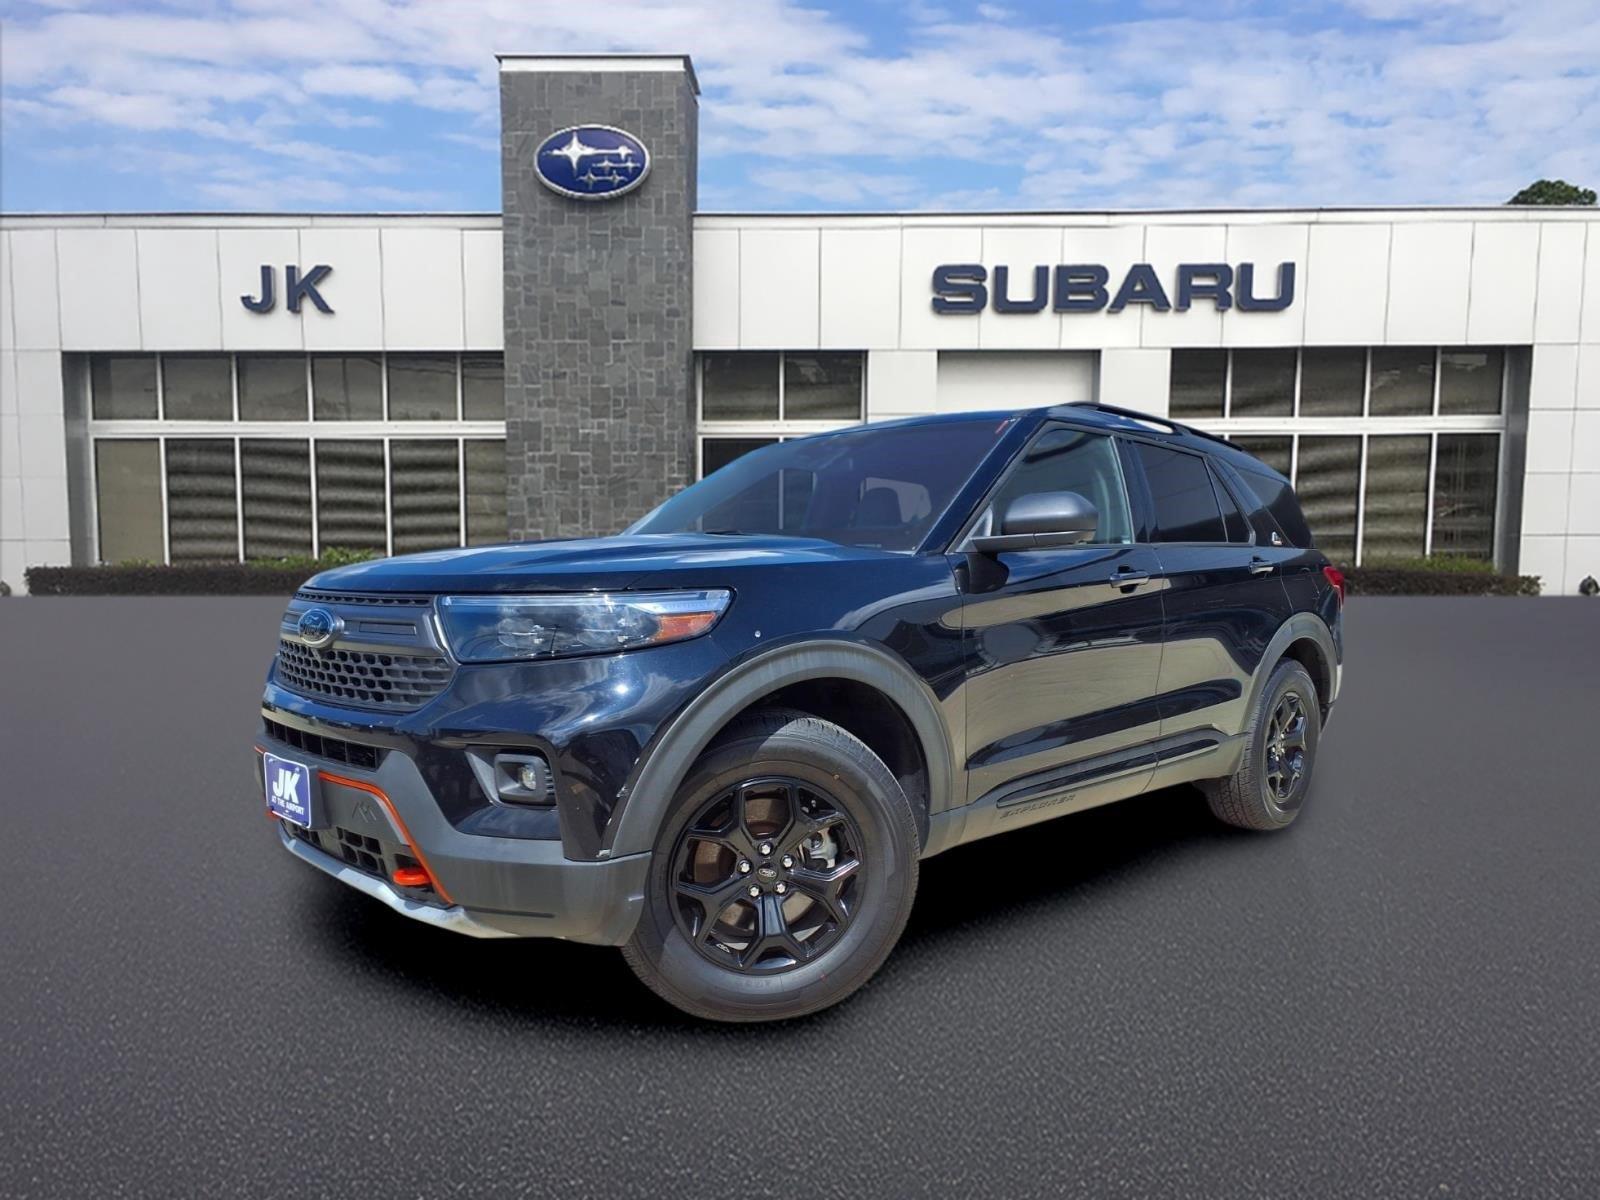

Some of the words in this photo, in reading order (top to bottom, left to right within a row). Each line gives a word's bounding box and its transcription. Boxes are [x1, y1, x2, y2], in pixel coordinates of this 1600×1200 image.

[240, 265, 335, 314] JK
[932, 262, 1296, 315] SUBARU
[272, 767, 300, 804] JK
[277, 797, 286, 808] THE
[286, 801, 305, 815] AIRPORT
